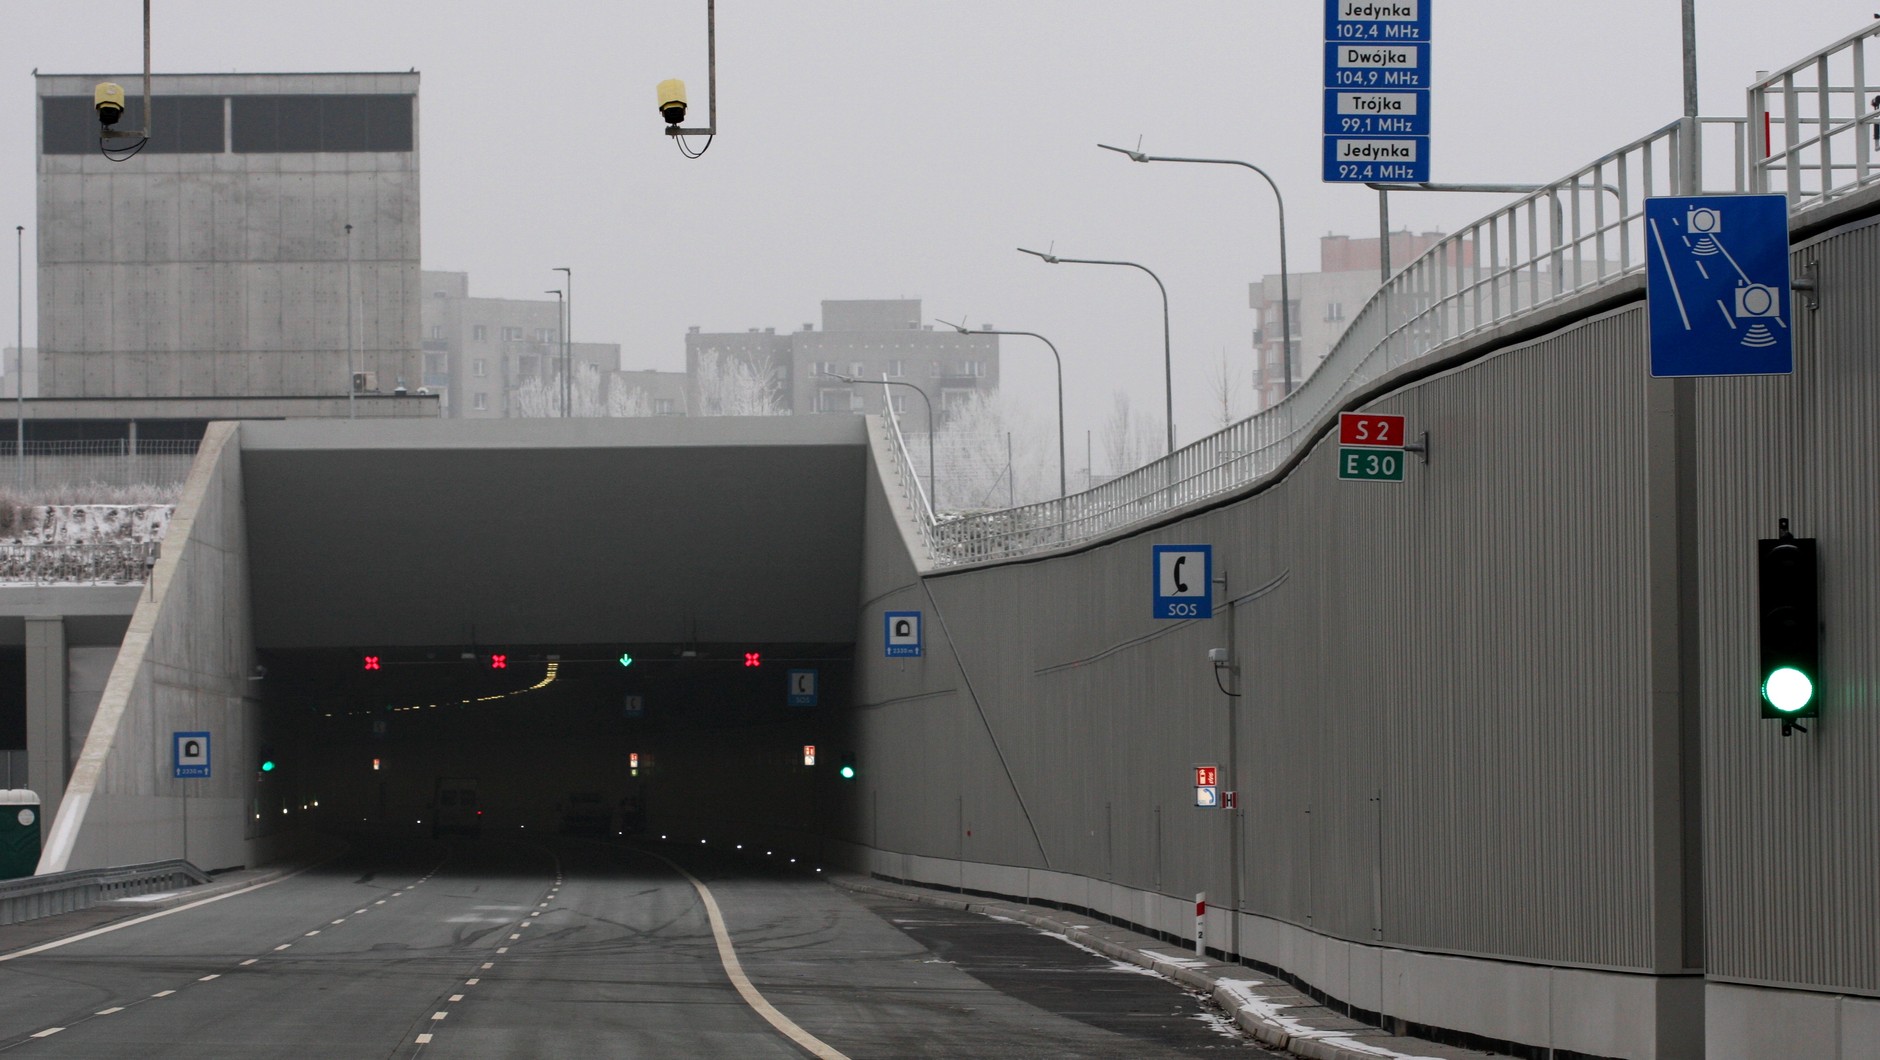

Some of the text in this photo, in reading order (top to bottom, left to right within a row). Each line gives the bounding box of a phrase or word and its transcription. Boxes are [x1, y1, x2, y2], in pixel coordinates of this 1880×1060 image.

[1345, 3, 1411, 20] Jedynka
[1336, 24, 1419, 39] 102,4 MHz
[1348, 49, 1406, 66] Dwójka
[1336, 71, 1418, 86] 104,9 MHz
[1352, 96, 1401, 113] Trójka
[1341, 118, 1412, 133] 99,1 MHz
[1343, 143, 1409, 161] Jedynka
[1339, 164, 1414, 180] 92,4 MHz
[1355, 420, 1389, 441] S 2
[1347, 454, 1396, 476] E 30
[1168, 603, 1197, 616] SOS
[1198, 931, 1203, 939] 2
